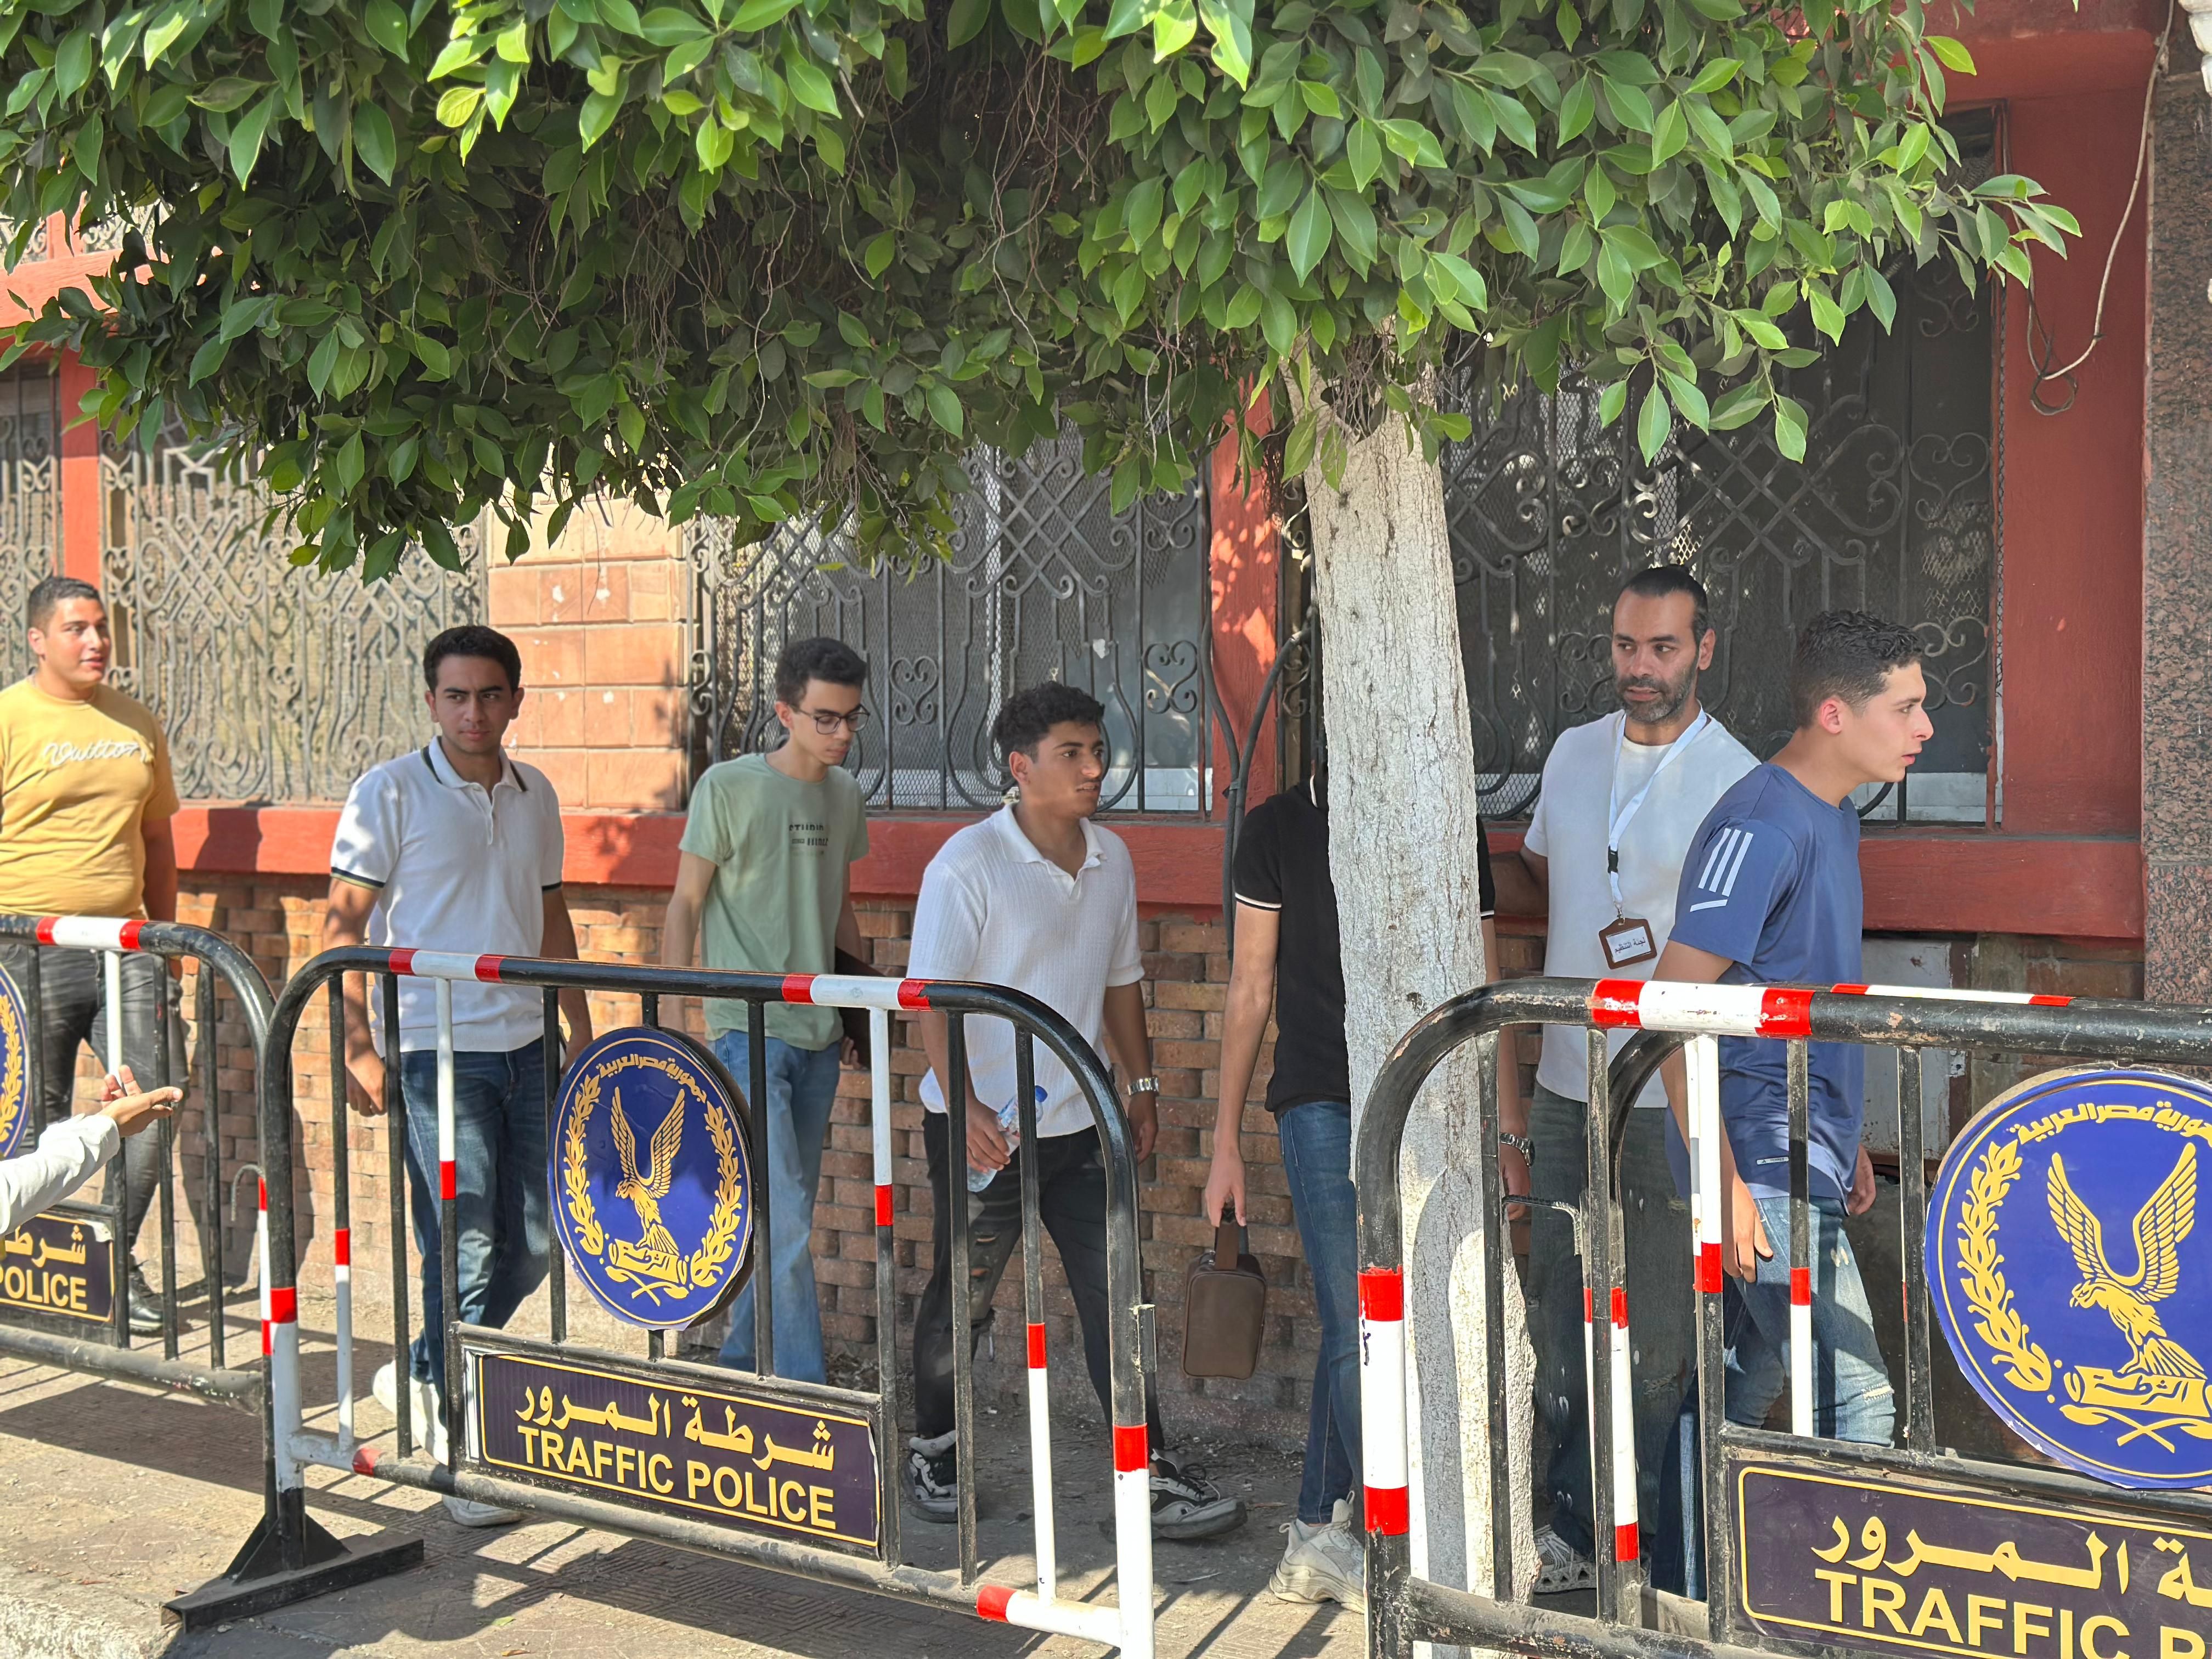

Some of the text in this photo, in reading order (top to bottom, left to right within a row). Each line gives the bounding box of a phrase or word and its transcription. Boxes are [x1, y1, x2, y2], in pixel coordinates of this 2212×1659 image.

[1633, 936, 1646, 947] لجنة
[596, 1053, 639, 1079] العربية
[637, 1056, 667, 1070] مصر
[2010, 1103, 2097, 1145] العربية
[2095, 1105, 2155, 1123] مصر
[5, 1224, 86, 1268] شرط
[0, 1265, 88, 1311] OLICE
[515, 1384, 834, 1471] شرطة المرور
[517, 1425, 837, 1530] TRAFFIC POLICE
[1810, 1515, 2129, 1595] المرور
[1815, 1568, 2130, 1659] TRAFFIC
